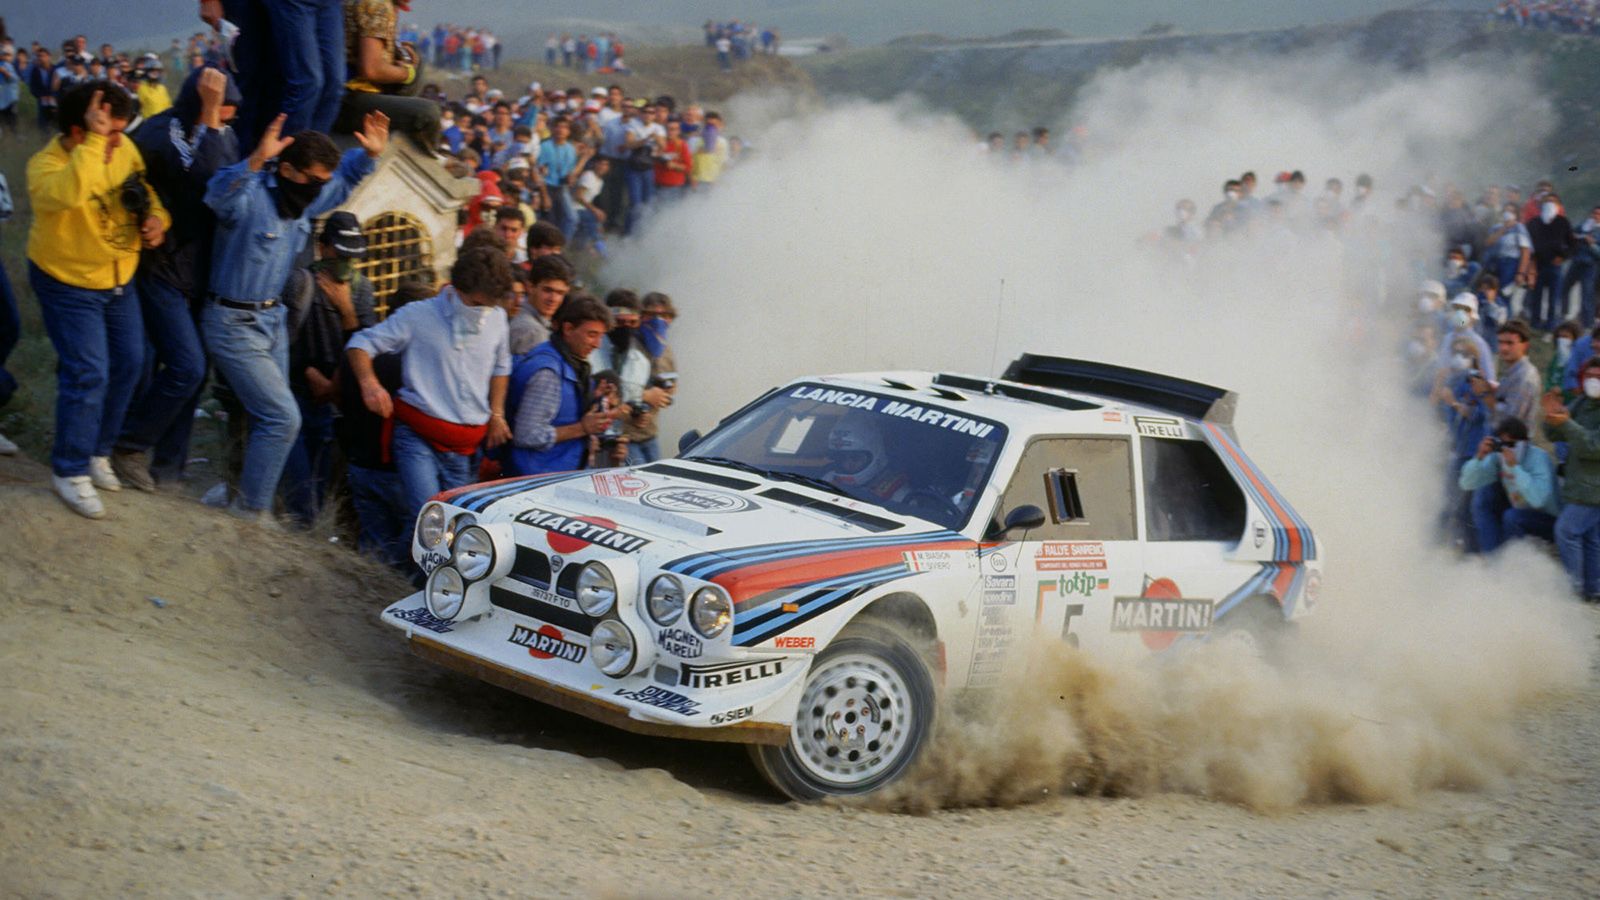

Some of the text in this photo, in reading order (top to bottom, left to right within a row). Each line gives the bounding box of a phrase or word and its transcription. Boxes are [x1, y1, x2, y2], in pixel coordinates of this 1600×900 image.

[790, 386, 995, 438] LANCIA MARTINI
[1133, 416, 1184, 437] PIRELLI
[520, 510, 645, 552] MARTINI
[421, 552, 449, 565] MAGN
[1059, 573, 1096, 597] totip
[1062, 604, 1085, 649] 5
[1114, 601, 1211, 627] MARTINI
[512, 627, 584, 662] MARTINI
[774, 637, 815, 648] WEBER
[679, 656, 788, 689] PIRELLI
[726, 706, 754, 721] SIEM
